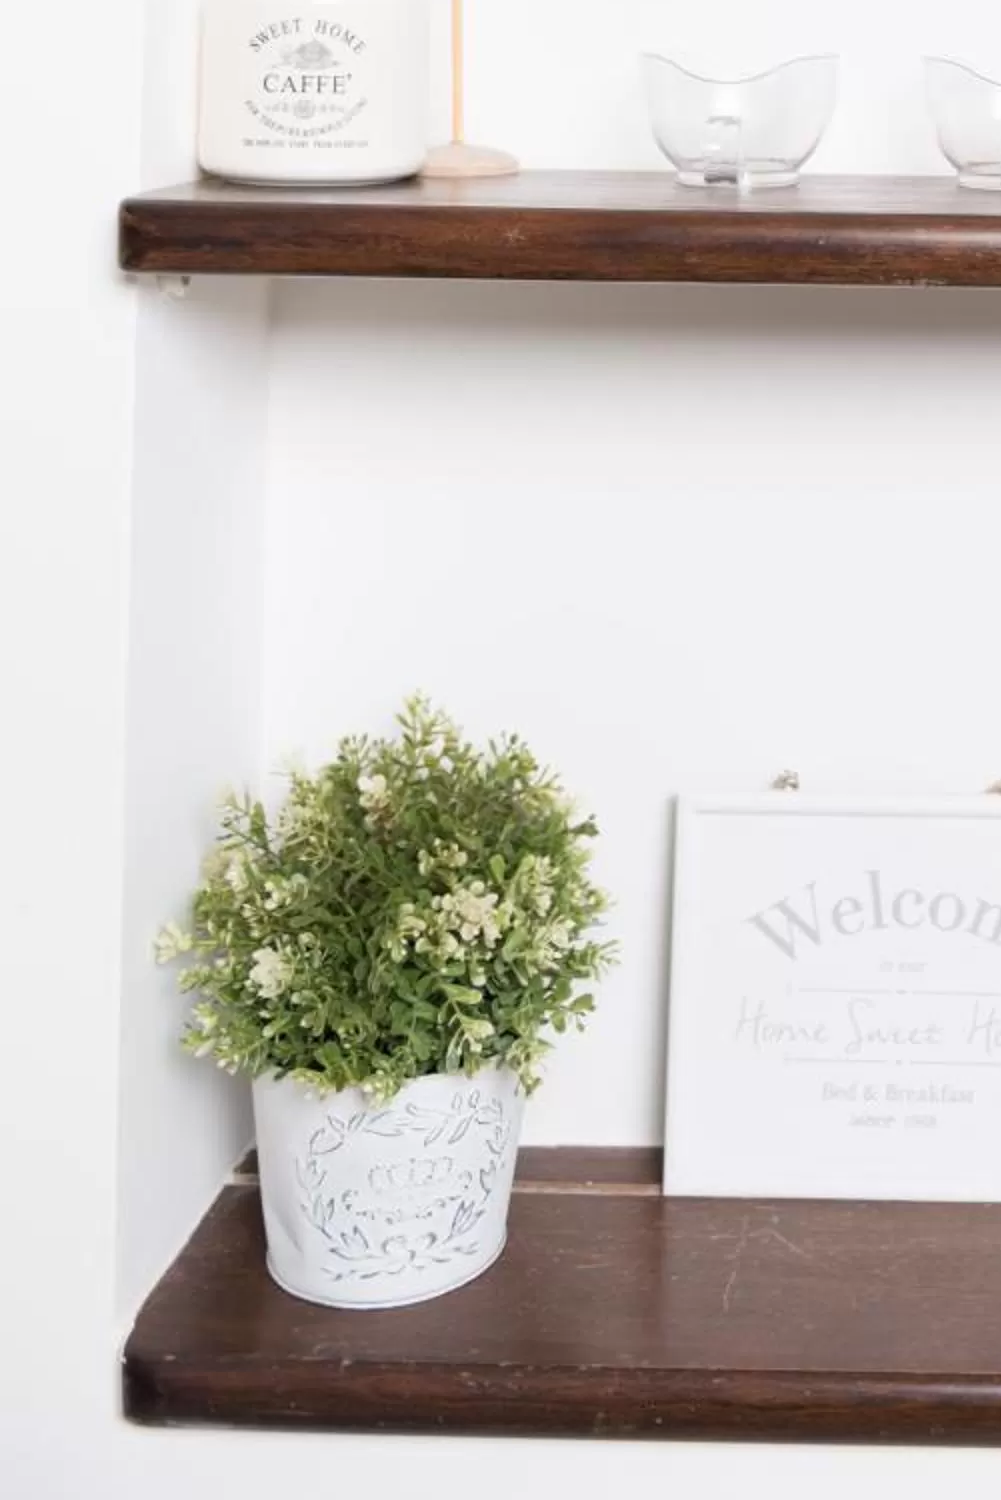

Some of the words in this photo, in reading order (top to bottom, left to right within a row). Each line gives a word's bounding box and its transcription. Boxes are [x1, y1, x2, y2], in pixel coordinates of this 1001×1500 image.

[249, 18, 301, 52] SWEET
[315, 19, 366, 54] HOME
[734, 995, 830, 1051] Home
[844, 997, 944, 1053] Sweet
